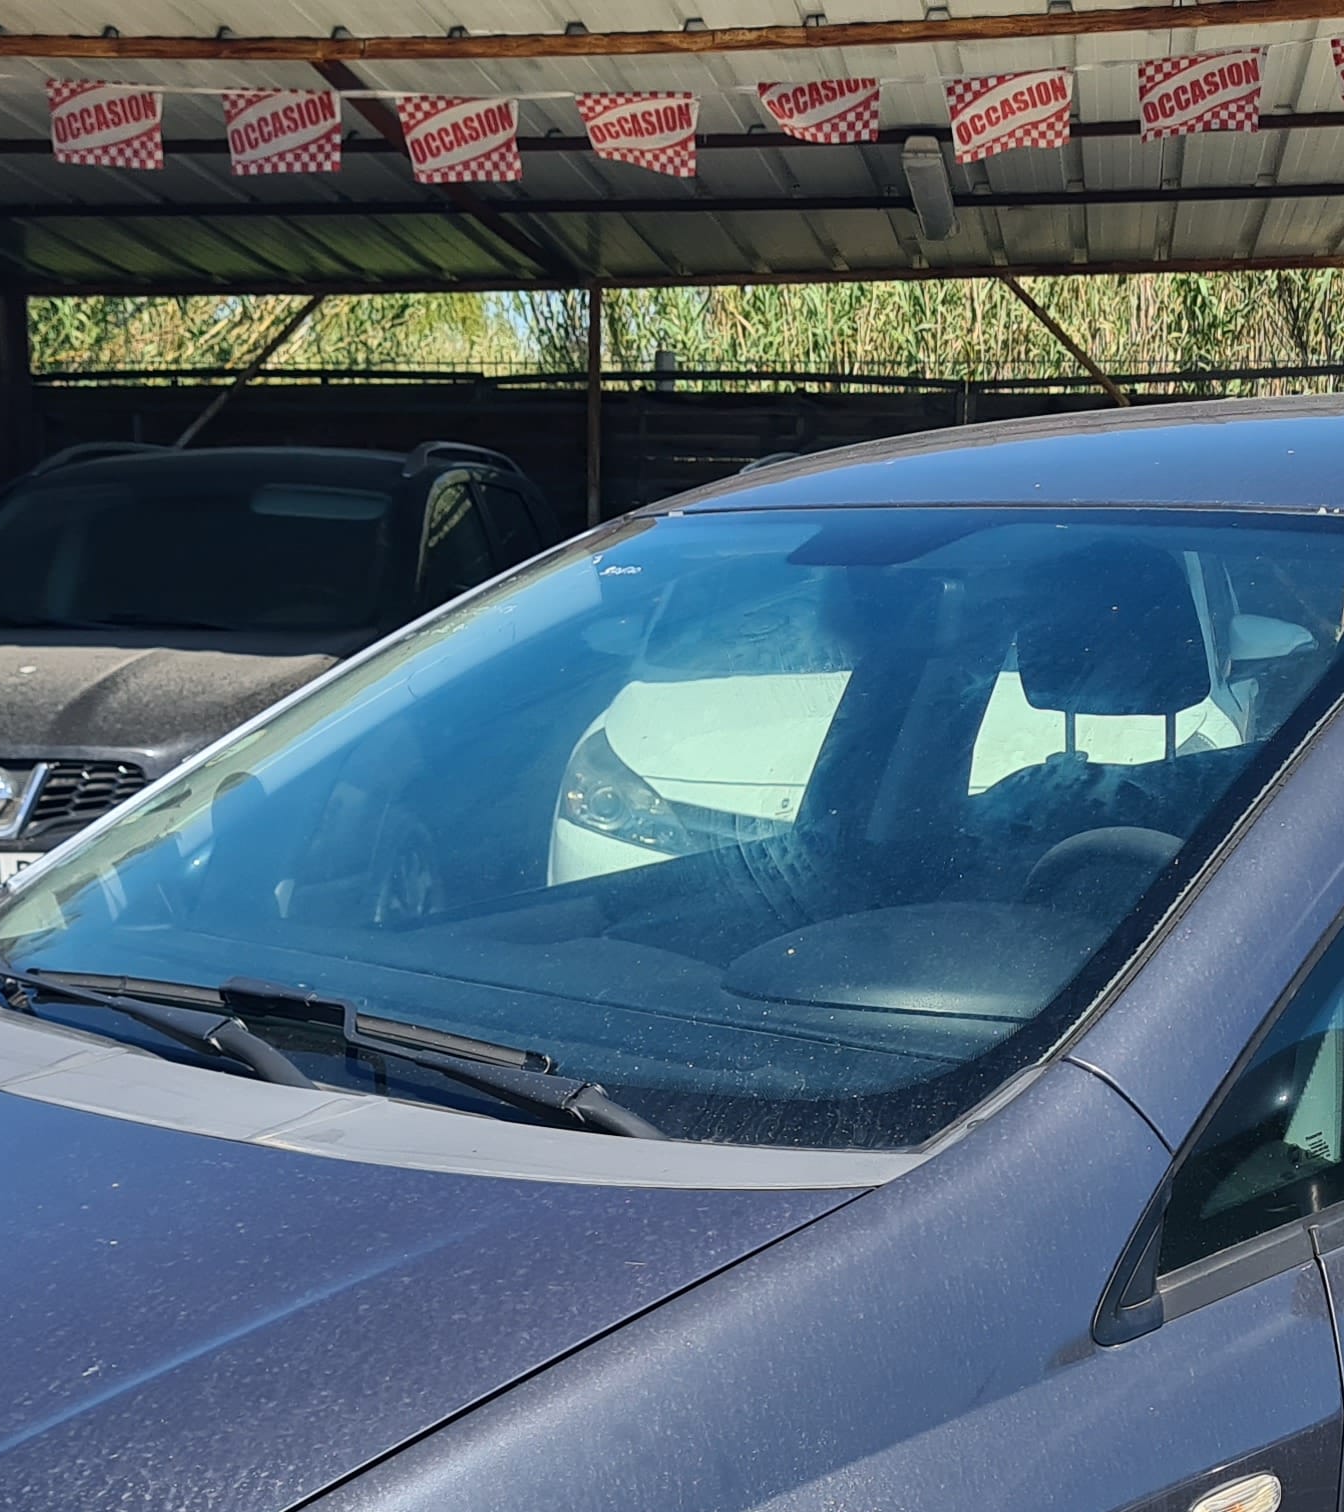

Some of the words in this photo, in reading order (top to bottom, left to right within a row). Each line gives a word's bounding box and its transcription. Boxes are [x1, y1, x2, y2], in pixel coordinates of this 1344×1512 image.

[55, 92, 156, 143] OCCASION
[956, 76, 1068, 146] OCCASION
[1143, 58, 1260, 124] OCCASION
[230, 92, 336, 155] OCCASION
[410, 102, 515, 164] OCCASION
[589, 103, 693, 144] OCCASION
